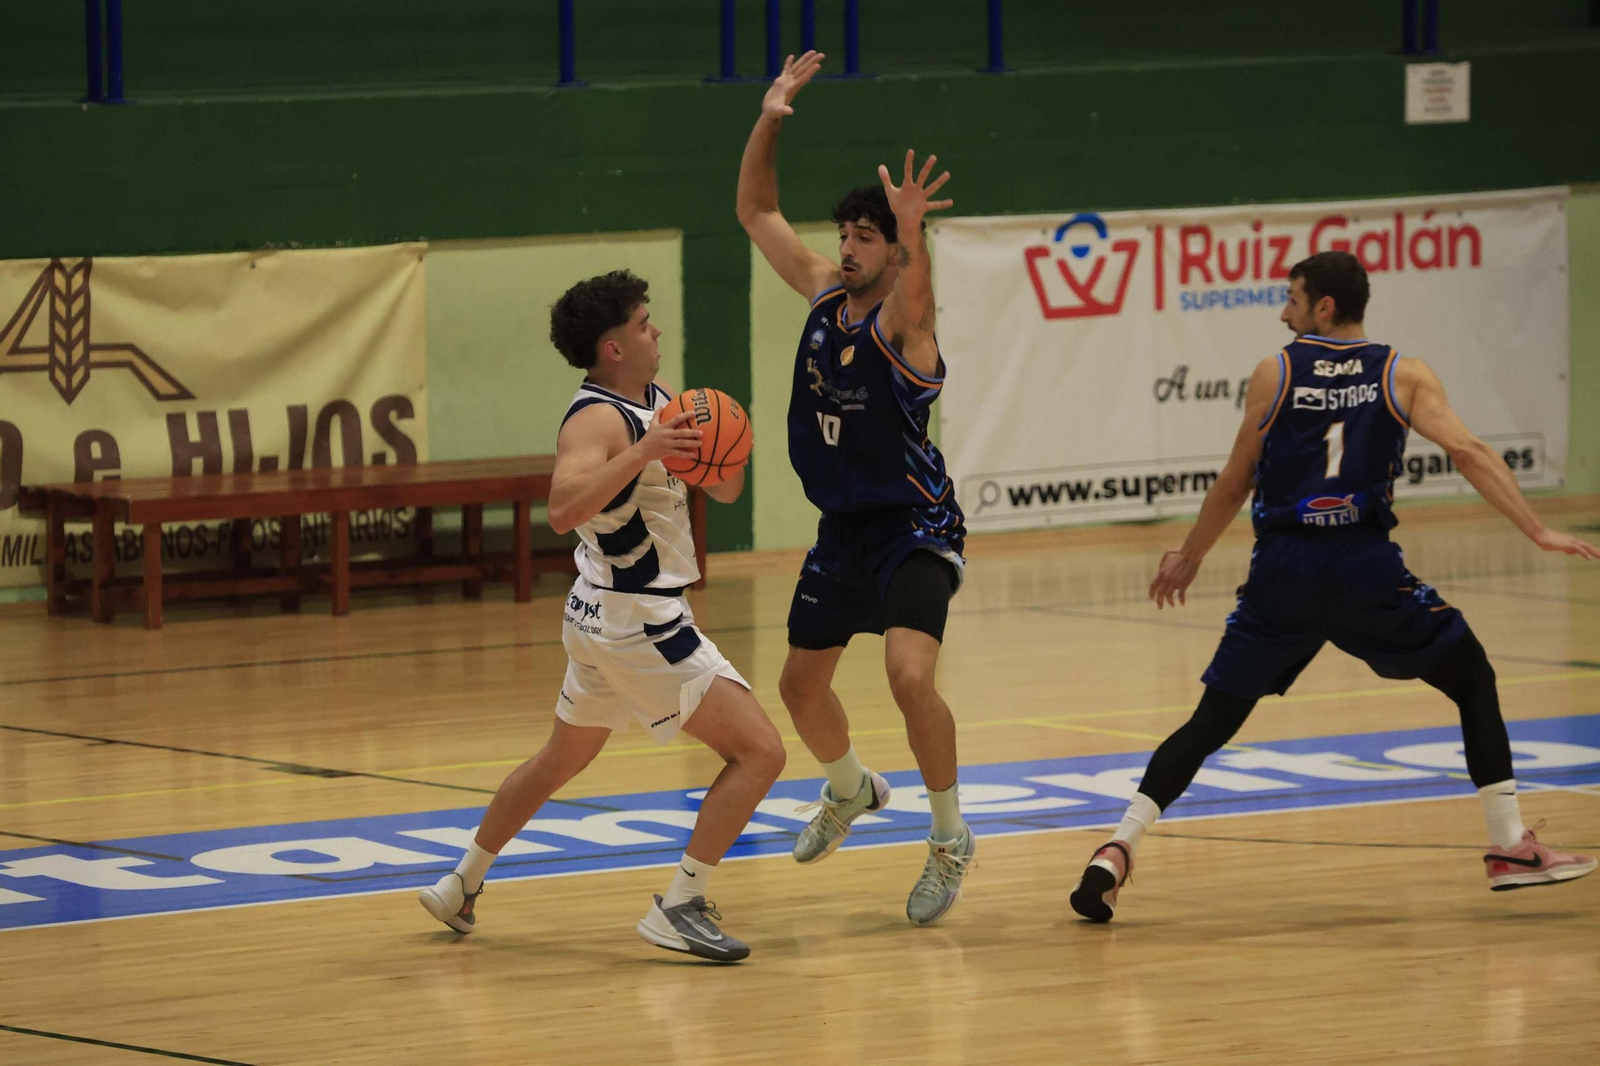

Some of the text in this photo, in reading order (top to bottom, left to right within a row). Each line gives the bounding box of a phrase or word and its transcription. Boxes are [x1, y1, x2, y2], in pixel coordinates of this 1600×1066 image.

[1178, 208, 1482, 285] Ruiz Galán
[1178, 286, 1290, 312] SUPERMER
[1153, 364, 1190, 404] A
[1194, 377, 1230, 400] un
[74, 429, 121, 482] e
[166, 395, 418, 477] HIJOS
[1323, 421, 1346, 479] 1
